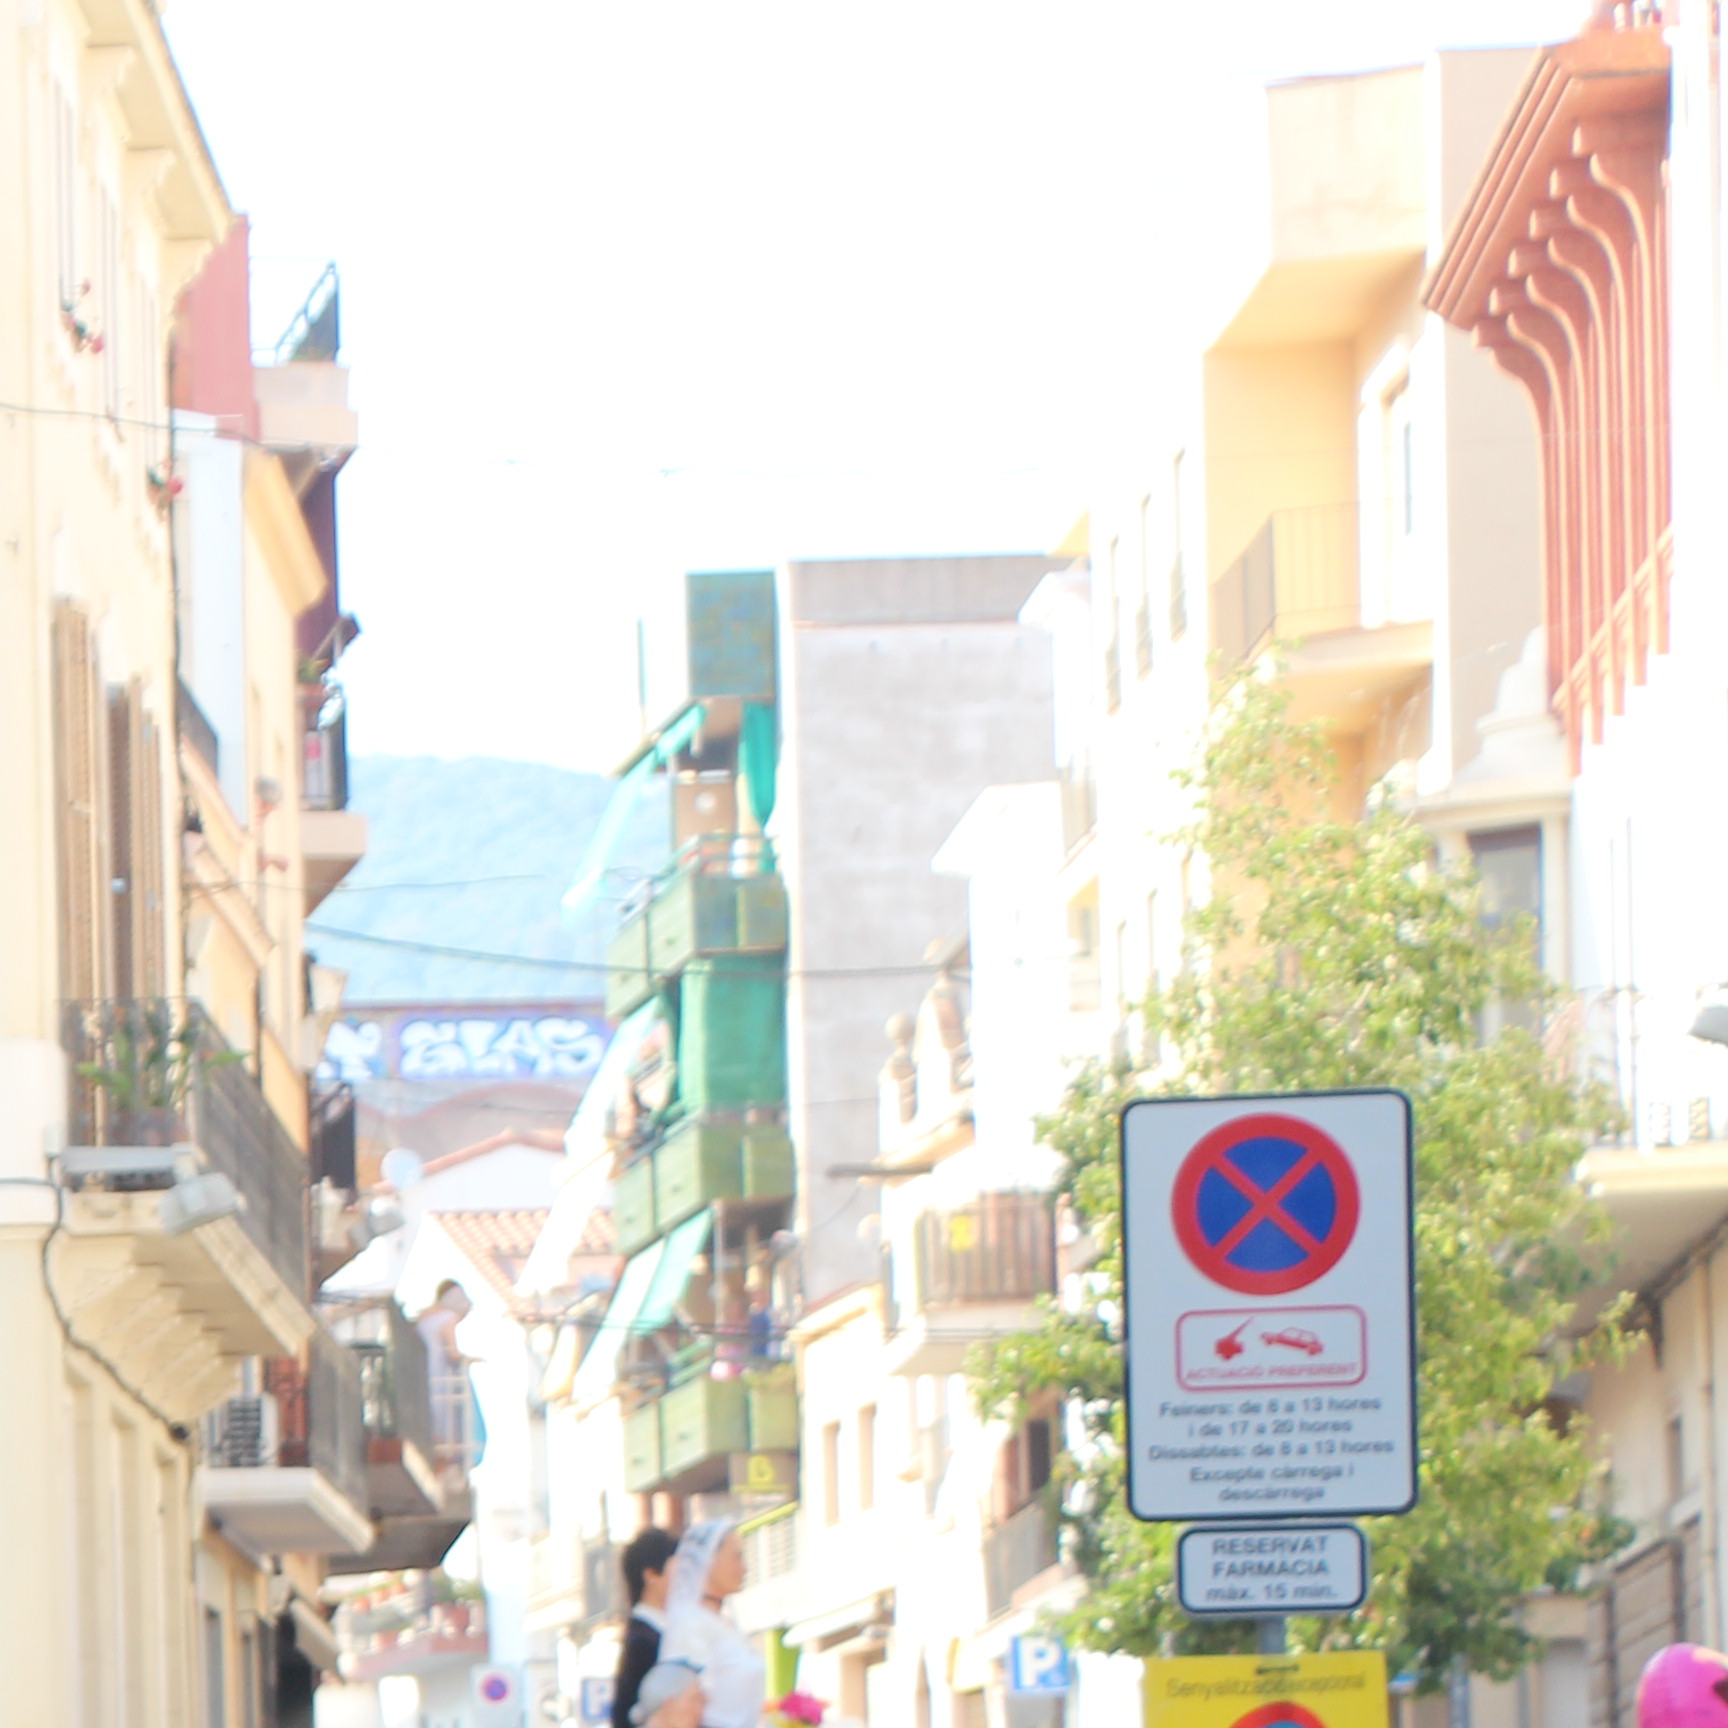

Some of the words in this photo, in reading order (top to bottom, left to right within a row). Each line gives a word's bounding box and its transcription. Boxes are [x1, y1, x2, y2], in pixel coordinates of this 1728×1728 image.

[1159, 1400, 1234, 1416] Feiners:
[1239, 1399, 1261, 1414] de
[1283, 1402, 1295, 1412] a
[1303, 1397, 1323, 1412] 13
[1327, 1397, 1381, 1411] hores
[1199, 1422, 1222, 1436] de
[1230, 1421, 1249, 1435] 17
[1255, 1424, 1266, 1434] a
[1272, 1420, 1295, 1434] 20
[1299, 1419, 1352, 1432] hores
[1251, 1442, 1274, 1456] de
[1296, 1445, 1308, 1455] a
[1314, 1440, 1336, 1454] 13
[1340, 1439, 1394, 1453] hores
[1190, 1466, 1265, 1483] Excepte
[1212, 1535, 1329, 1555] RESERVAT
[1263, 1583, 1286, 1599] 15
